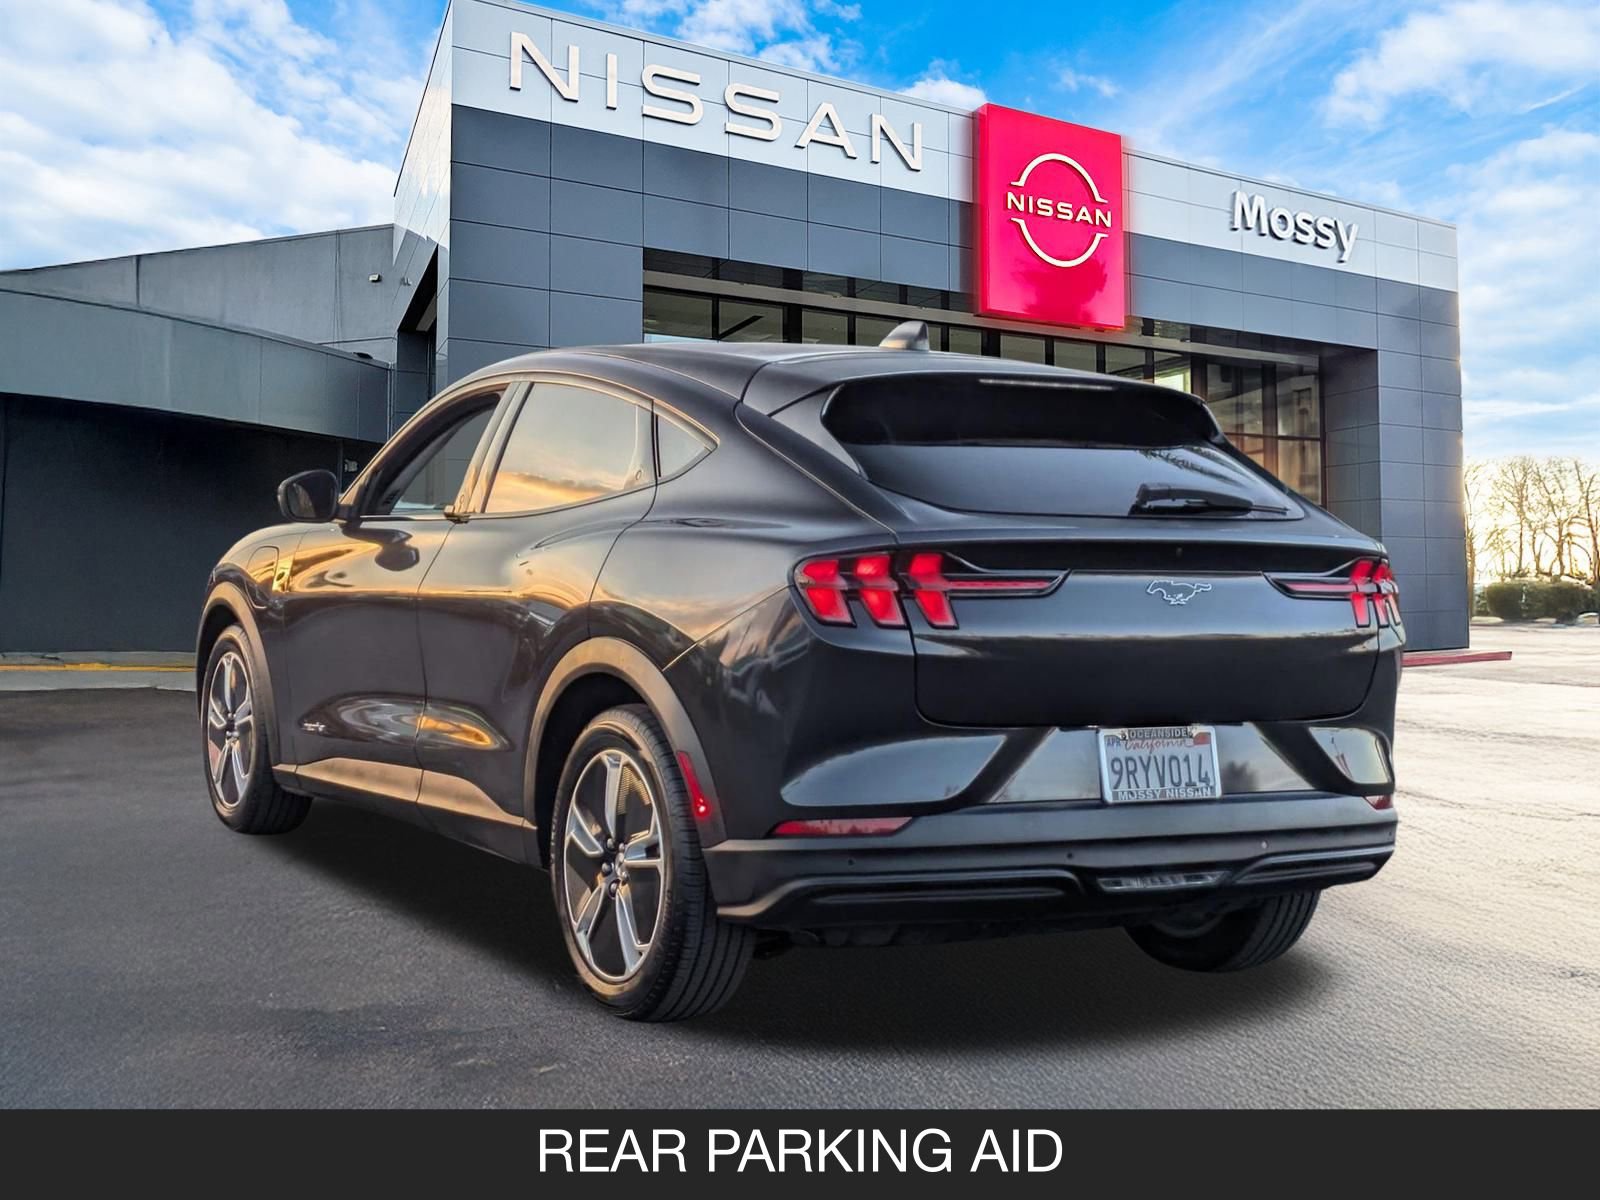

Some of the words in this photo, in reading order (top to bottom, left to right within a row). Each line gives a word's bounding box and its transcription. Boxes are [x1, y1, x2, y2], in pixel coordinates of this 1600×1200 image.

[509, 31, 923, 171] NISSAN
[1006, 191, 1112, 228] NISSAN
[1231, 191, 1359, 263] Mossy
[1129, 728, 1187, 740] OCEANSIDE
[1110, 754, 1210, 790] 9RYV014
[1118, 789, 1161, 800] MOSSY
[1165, 787, 1211, 798] NISSAN
